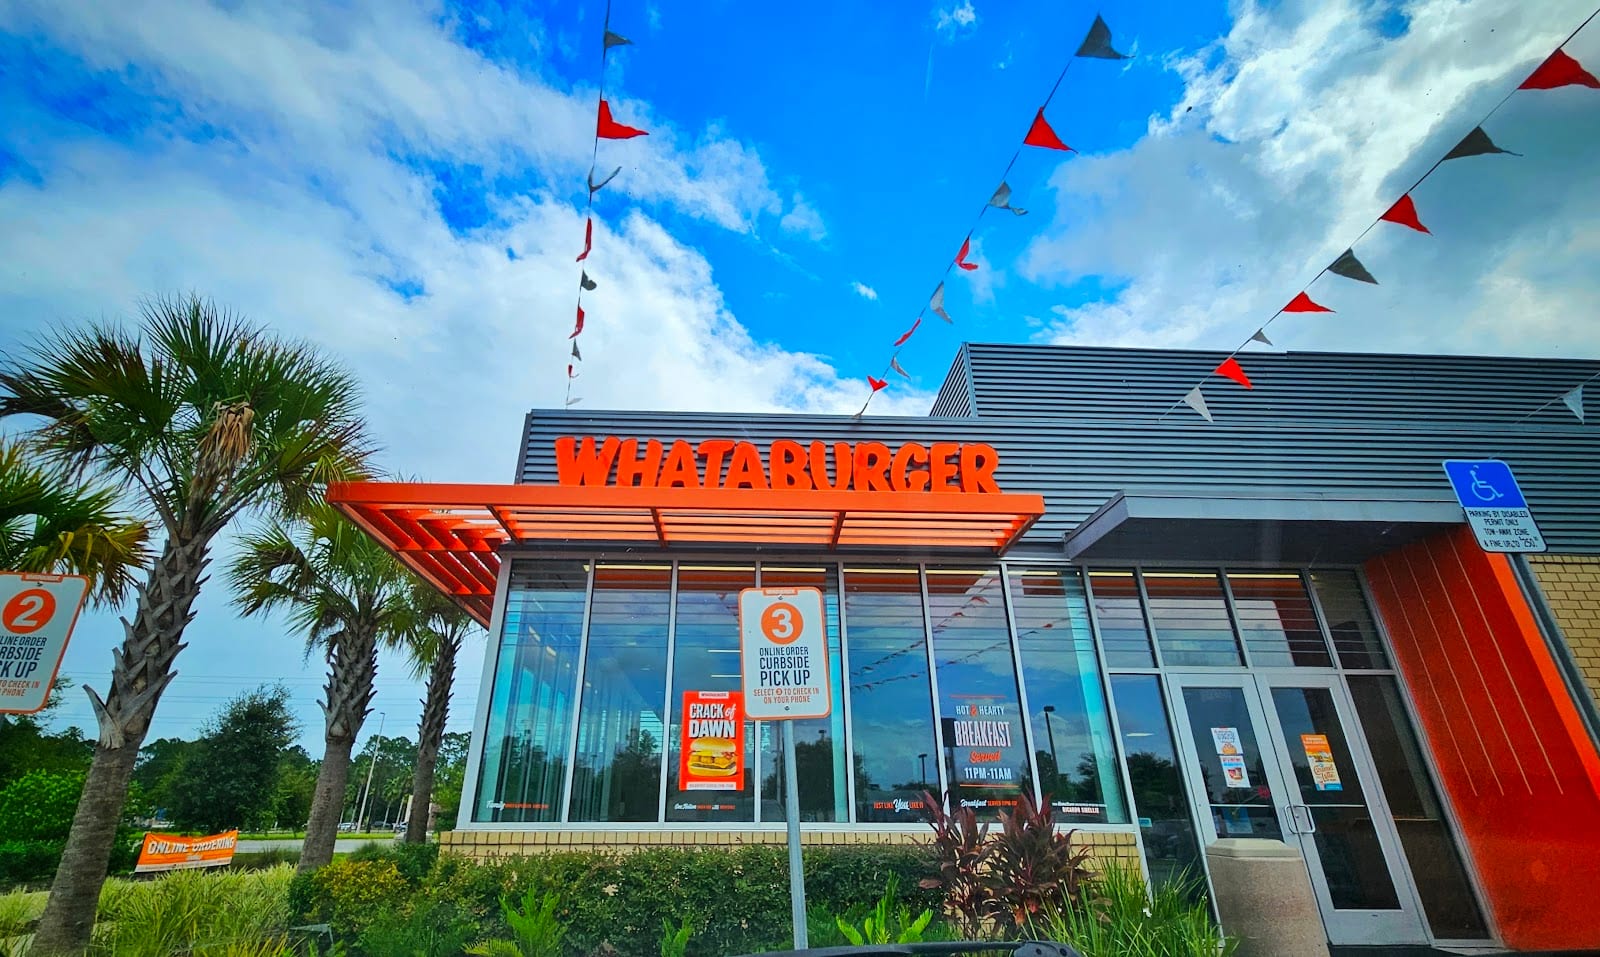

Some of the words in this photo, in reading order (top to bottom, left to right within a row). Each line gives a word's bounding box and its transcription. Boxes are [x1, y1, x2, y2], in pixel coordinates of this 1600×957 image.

[555, 436, 1002, 494] WHATABURGER
[1504, 518, 1519, 526] ONLY
[1483, 527, 1511, 535] TOW-AWAY
[11, 595, 44, 627] 2
[771, 608, 794, 639] 3
[0, 636, 19, 646] LINE
[19, 636, 47, 647] ORDER
[759, 646, 785, 656] ONLINE
[786, 646, 809, 656] ORDER
[15, 661, 38, 678] UP
[759, 656, 810, 670] CURBSIDE
[8, 680, 31, 689] CHECK
[760, 670, 790, 687] PICK
[794, 670, 811, 686] UP
[2, 688, 26, 697] PHONE
[753, 688, 775, 697] SELECT
[784, 688, 792, 696] TO
[792, 687, 812, 696] CHECK
[812, 687, 820, 695] IN
[763, 696, 772, 704] ON
[773, 696, 790, 704] YOUR
[790, 695, 811, 704] PHONE
[690, 703, 724, 719] CRACK
[724, 703, 737, 721] of
[955, 705, 969, 715] HOT
[978, 705, 1005, 715] HEARTY
[688, 719, 736, 738] DAWN
[953, 720, 1011, 747] BREAKFAST
[969, 750, 1002, 764] Served
[964, 767, 1012, 780] 11PM-11AM
[961, 799, 987, 808] Breakfast
[147, 840, 190, 855] ONLINE
[191, 836, 235, 852] ORDERING
